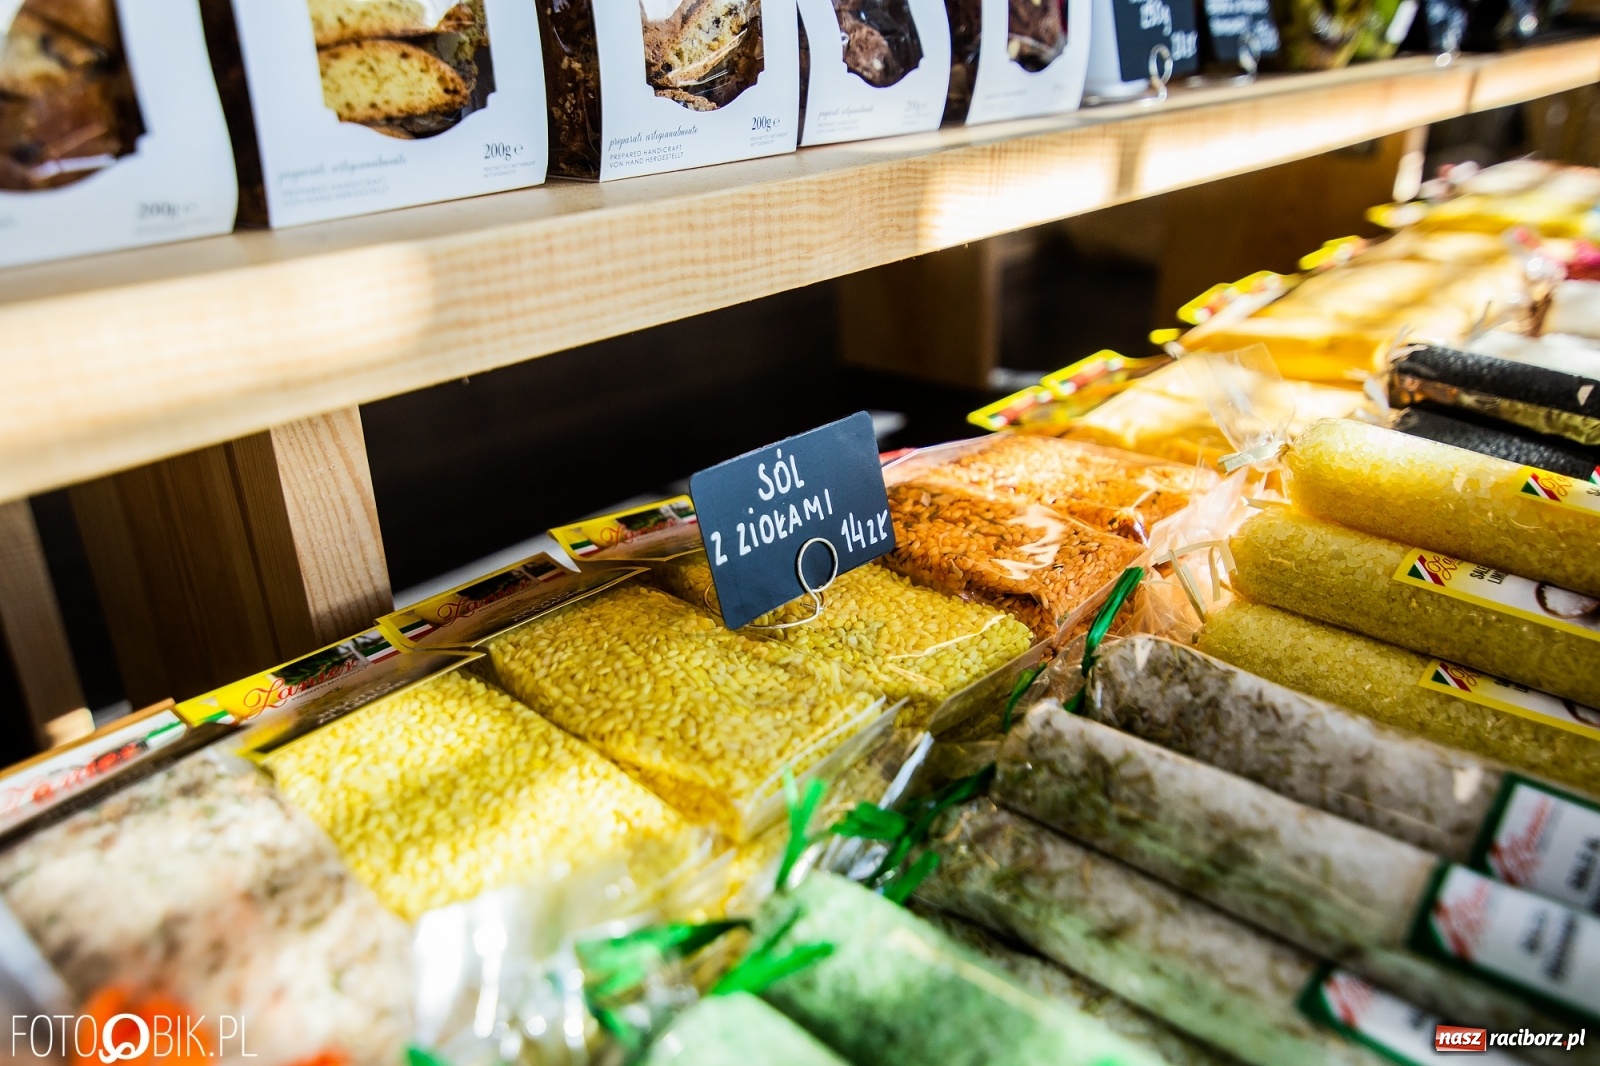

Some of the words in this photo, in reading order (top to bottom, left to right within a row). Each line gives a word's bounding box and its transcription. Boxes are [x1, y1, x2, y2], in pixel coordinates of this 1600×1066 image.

[752, 116, 771, 132] 200g
[608, 132, 642, 151] preparati
[645, 125, 698, 143] artigianalmente
[484, 142, 512, 161] 200g
[610, 150, 641, 160] PREPARED
[643, 144, 682, 155] HANDICRAFT
[625, 157, 643, 166] HAND
[645, 152, 684, 163] HERGESTELLT
[757, 448, 805, 501] SÓL
